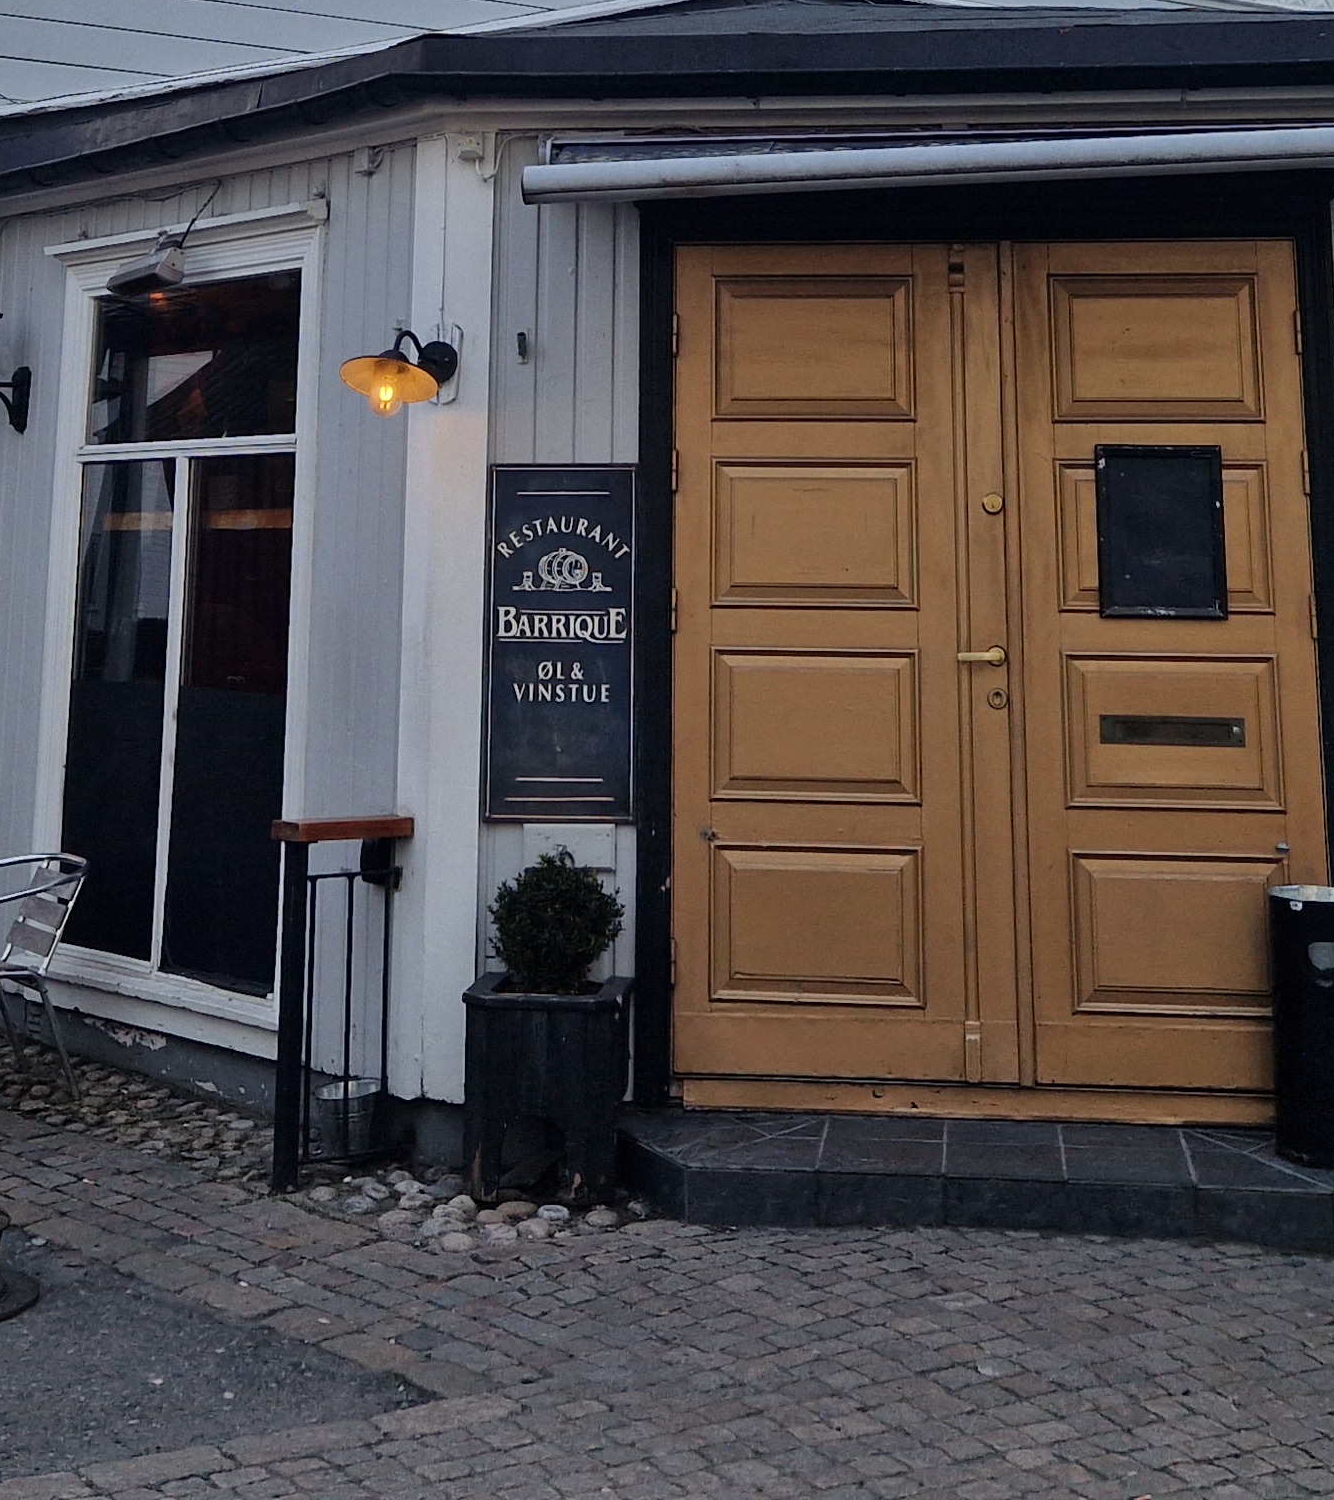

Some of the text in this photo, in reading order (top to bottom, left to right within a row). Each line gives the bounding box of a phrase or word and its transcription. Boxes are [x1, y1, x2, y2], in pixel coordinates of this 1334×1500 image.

[496, 516, 630, 560] RESTAURANT
[497, 606, 627, 642] BARRIQUE
[538, 661, 585, 681] ØL &
[513, 683, 611, 703] VINSTUE
